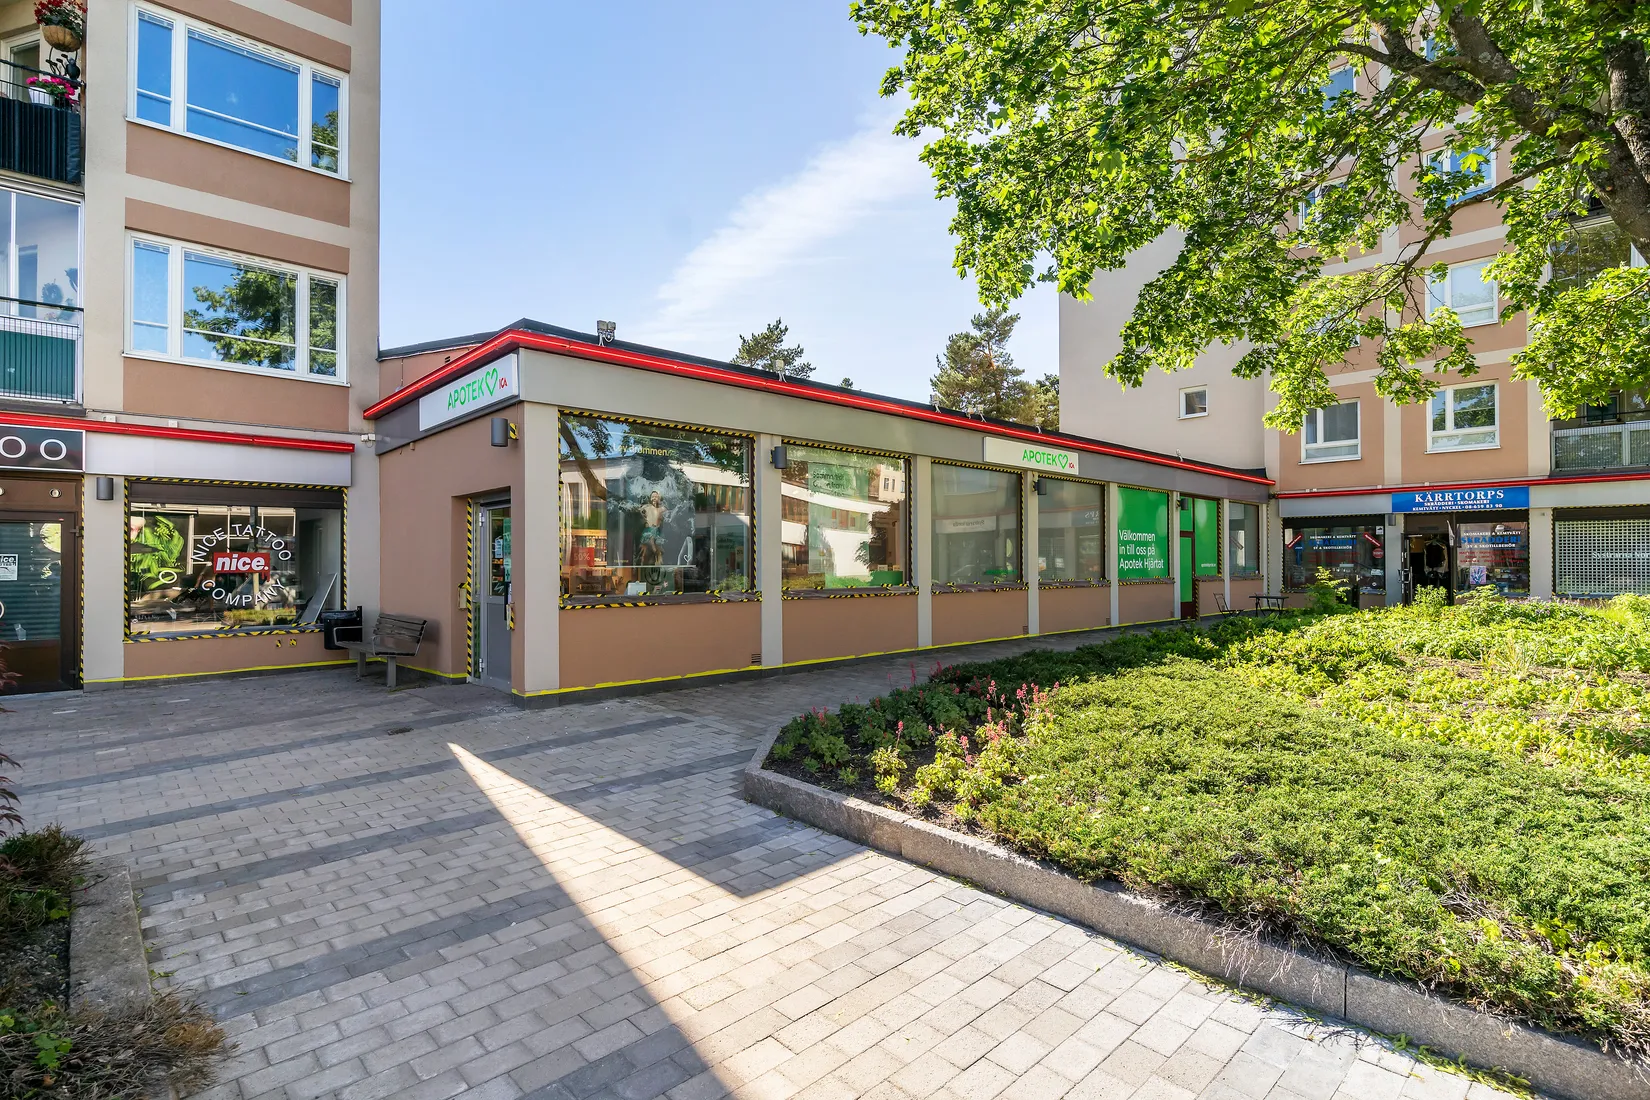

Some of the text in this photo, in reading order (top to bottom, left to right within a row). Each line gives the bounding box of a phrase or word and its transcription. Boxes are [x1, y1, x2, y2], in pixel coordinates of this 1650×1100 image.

[447, 377, 508, 411] APOTEK ICA
[1022, 449, 1058, 466] APOTEK
[1414, 489, 1505, 503] KÄRRTORPS
[191, 523, 292, 562] NICE TATTOO
[1118, 529, 1156, 541] Välkommen
[1461, 535, 1521, 544] SKRÄDDERI
[1119, 544, 1126, 554] in
[1136, 546, 1146, 555] oss
[1147, 543, 1155, 556] på
[215, 553, 269, 571] nice.
[1119, 558, 1164, 571] Apotek Hjärtat
[201, 578, 285, 607] COMPANY
